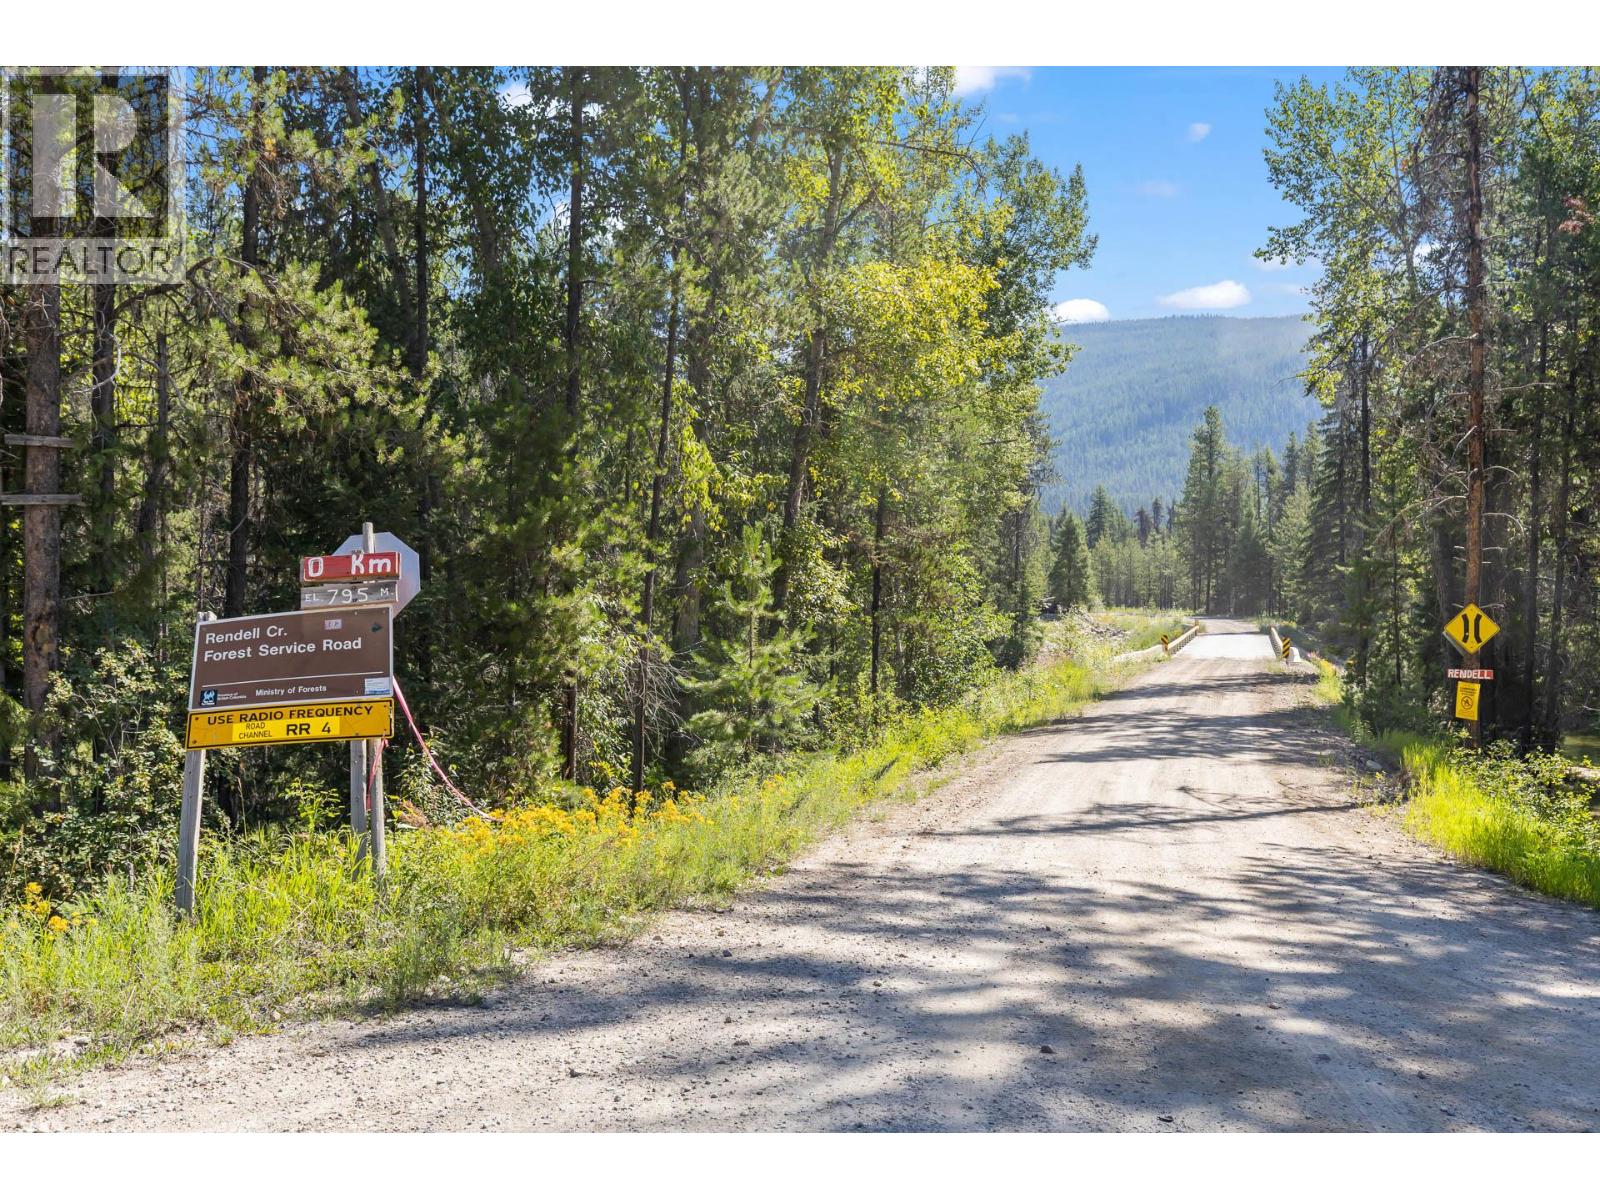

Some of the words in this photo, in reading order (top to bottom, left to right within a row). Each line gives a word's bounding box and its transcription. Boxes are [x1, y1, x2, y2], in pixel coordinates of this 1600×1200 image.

[351, 551, 391, 575] Km
[327, 588, 369, 604] 795
[205, 627, 260, 644] Rendell
[266, 625, 288, 638] Cr.
[204, 648, 252, 662] Forest
[259, 641, 316, 657] Service
[323, 637, 362, 651] Road
[1448, 669, 1491, 679] RENDELL
[255, 687, 285, 697] Ministry
[287, 686, 296, 694] of
[298, 684, 327, 693] Forests
[207, 714, 234, 725] USE
[239, 710, 284, 723] RADIO
[289, 705, 374, 719] FREQUENCY
[245, 722, 266, 731] ROAD
[286, 723, 311, 737] RR
[322, 721, 332, 734] 4
[238, 731, 273, 740] CHANNEL
